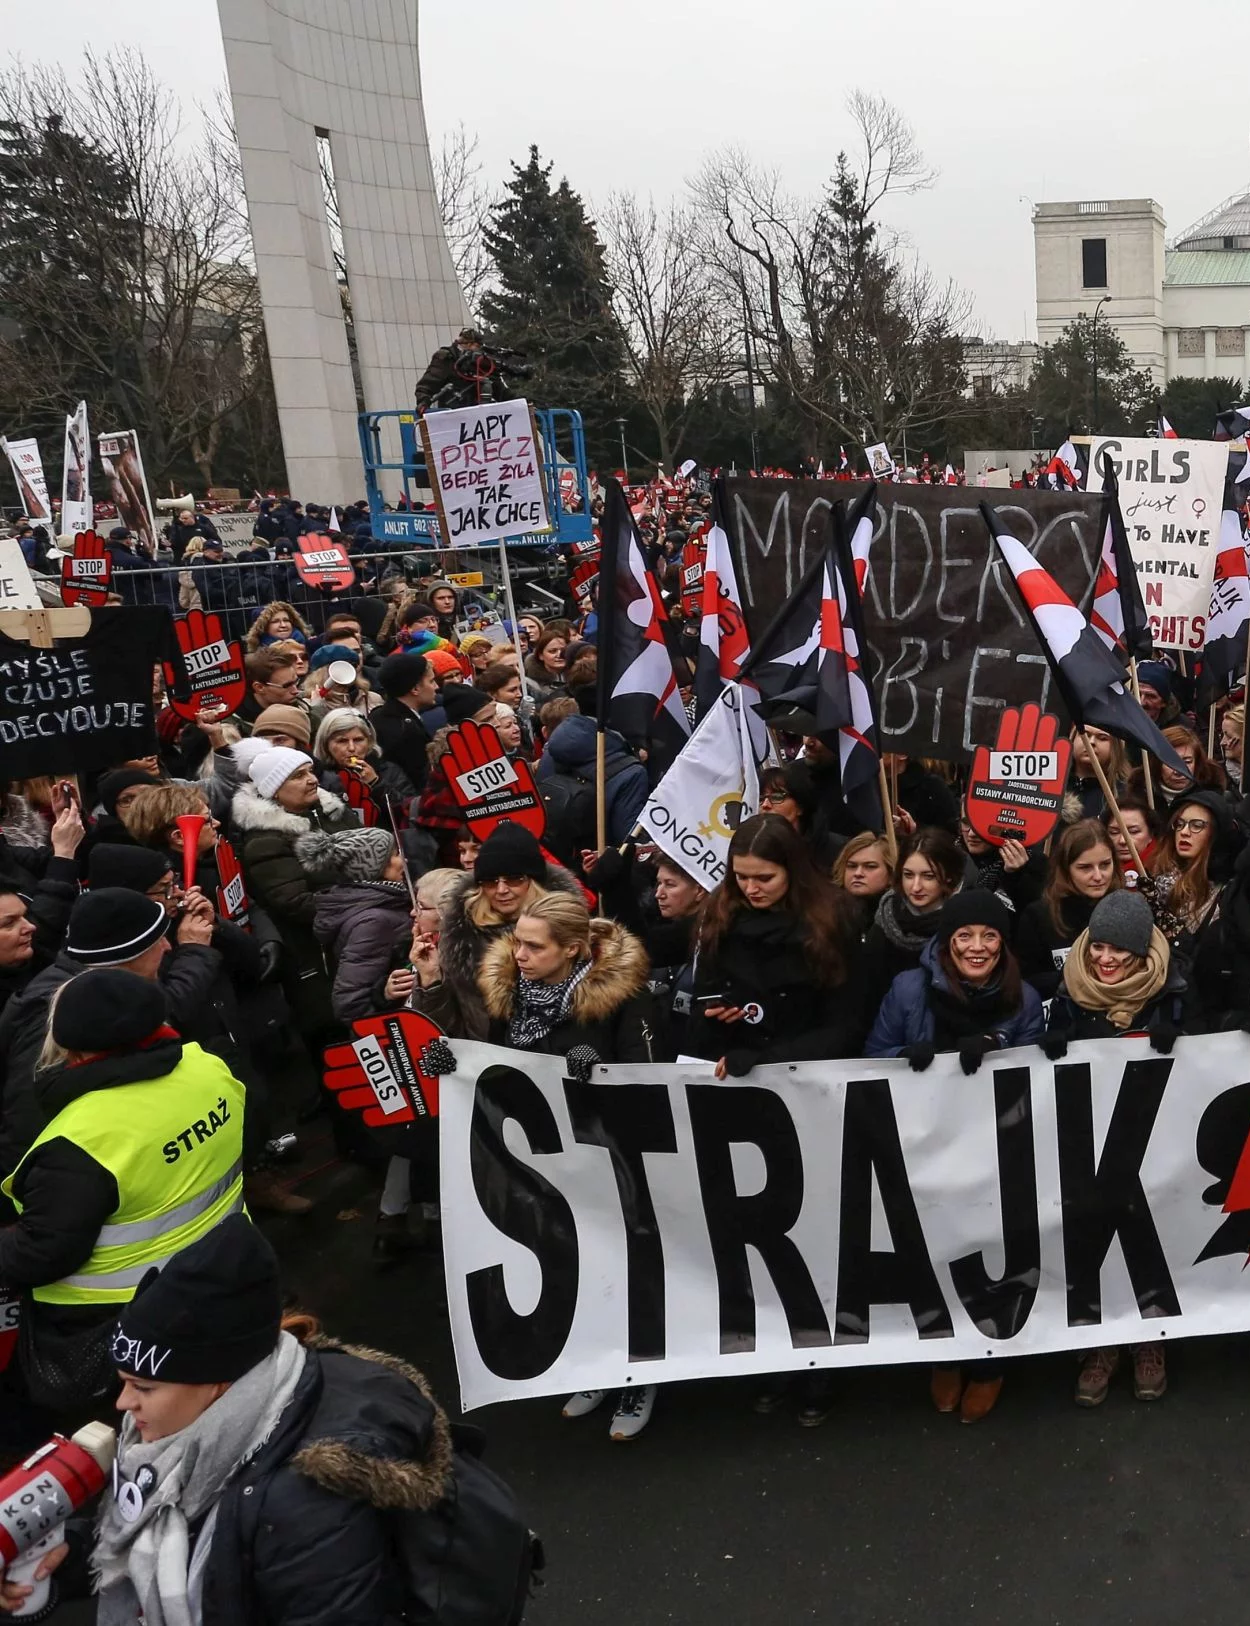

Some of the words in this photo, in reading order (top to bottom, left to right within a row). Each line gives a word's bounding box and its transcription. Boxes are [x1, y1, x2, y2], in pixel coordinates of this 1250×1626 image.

[459, 414, 512, 445] ŁAPY
[441, 436, 532, 471] PRECZ
[441, 468, 489, 490] BĘDĘ
[475, 484, 513, 505] TAK
[1126, 491, 1178, 517] just
[384, 521, 409, 536] ANLIFT
[450, 506, 490, 537] JAK
[495, 502, 541, 526] CHCĘ
[1161, 524, 1210, 547] HAVE
[78, 561, 102, 574] STOP
[309, 551, 337, 563] STOP
[1134, 560, 1199, 579] MENTAL
[687, 565, 700, 581] STOP
[1148, 616, 1206, 649] GHTS
[184, 645, 221, 672] STOP
[5, 675, 94, 704] CZUJE
[466, 762, 506, 794] STOP
[1001, 755, 1050, 776] STOP
[975, 787, 1002, 799] USTAWY
[1002, 791, 1057, 809] ANTYABORCYJNEJ
[1007, 781, 1038, 792] ZAOSTRZENIU
[466, 808, 488, 818] USTAWY
[648, 798, 727, 882] ONGRE
[227, 878, 241, 908] STOP
[389, 1022, 417, 1086] ANTYABORCYJNEJ
[360, 1047, 398, 1101] STOP
[409, 1085, 426, 1115] USTAWY
[162, 1097, 231, 1164] STRAŻ
[466, 1058, 1182, 1381] STRAJK
